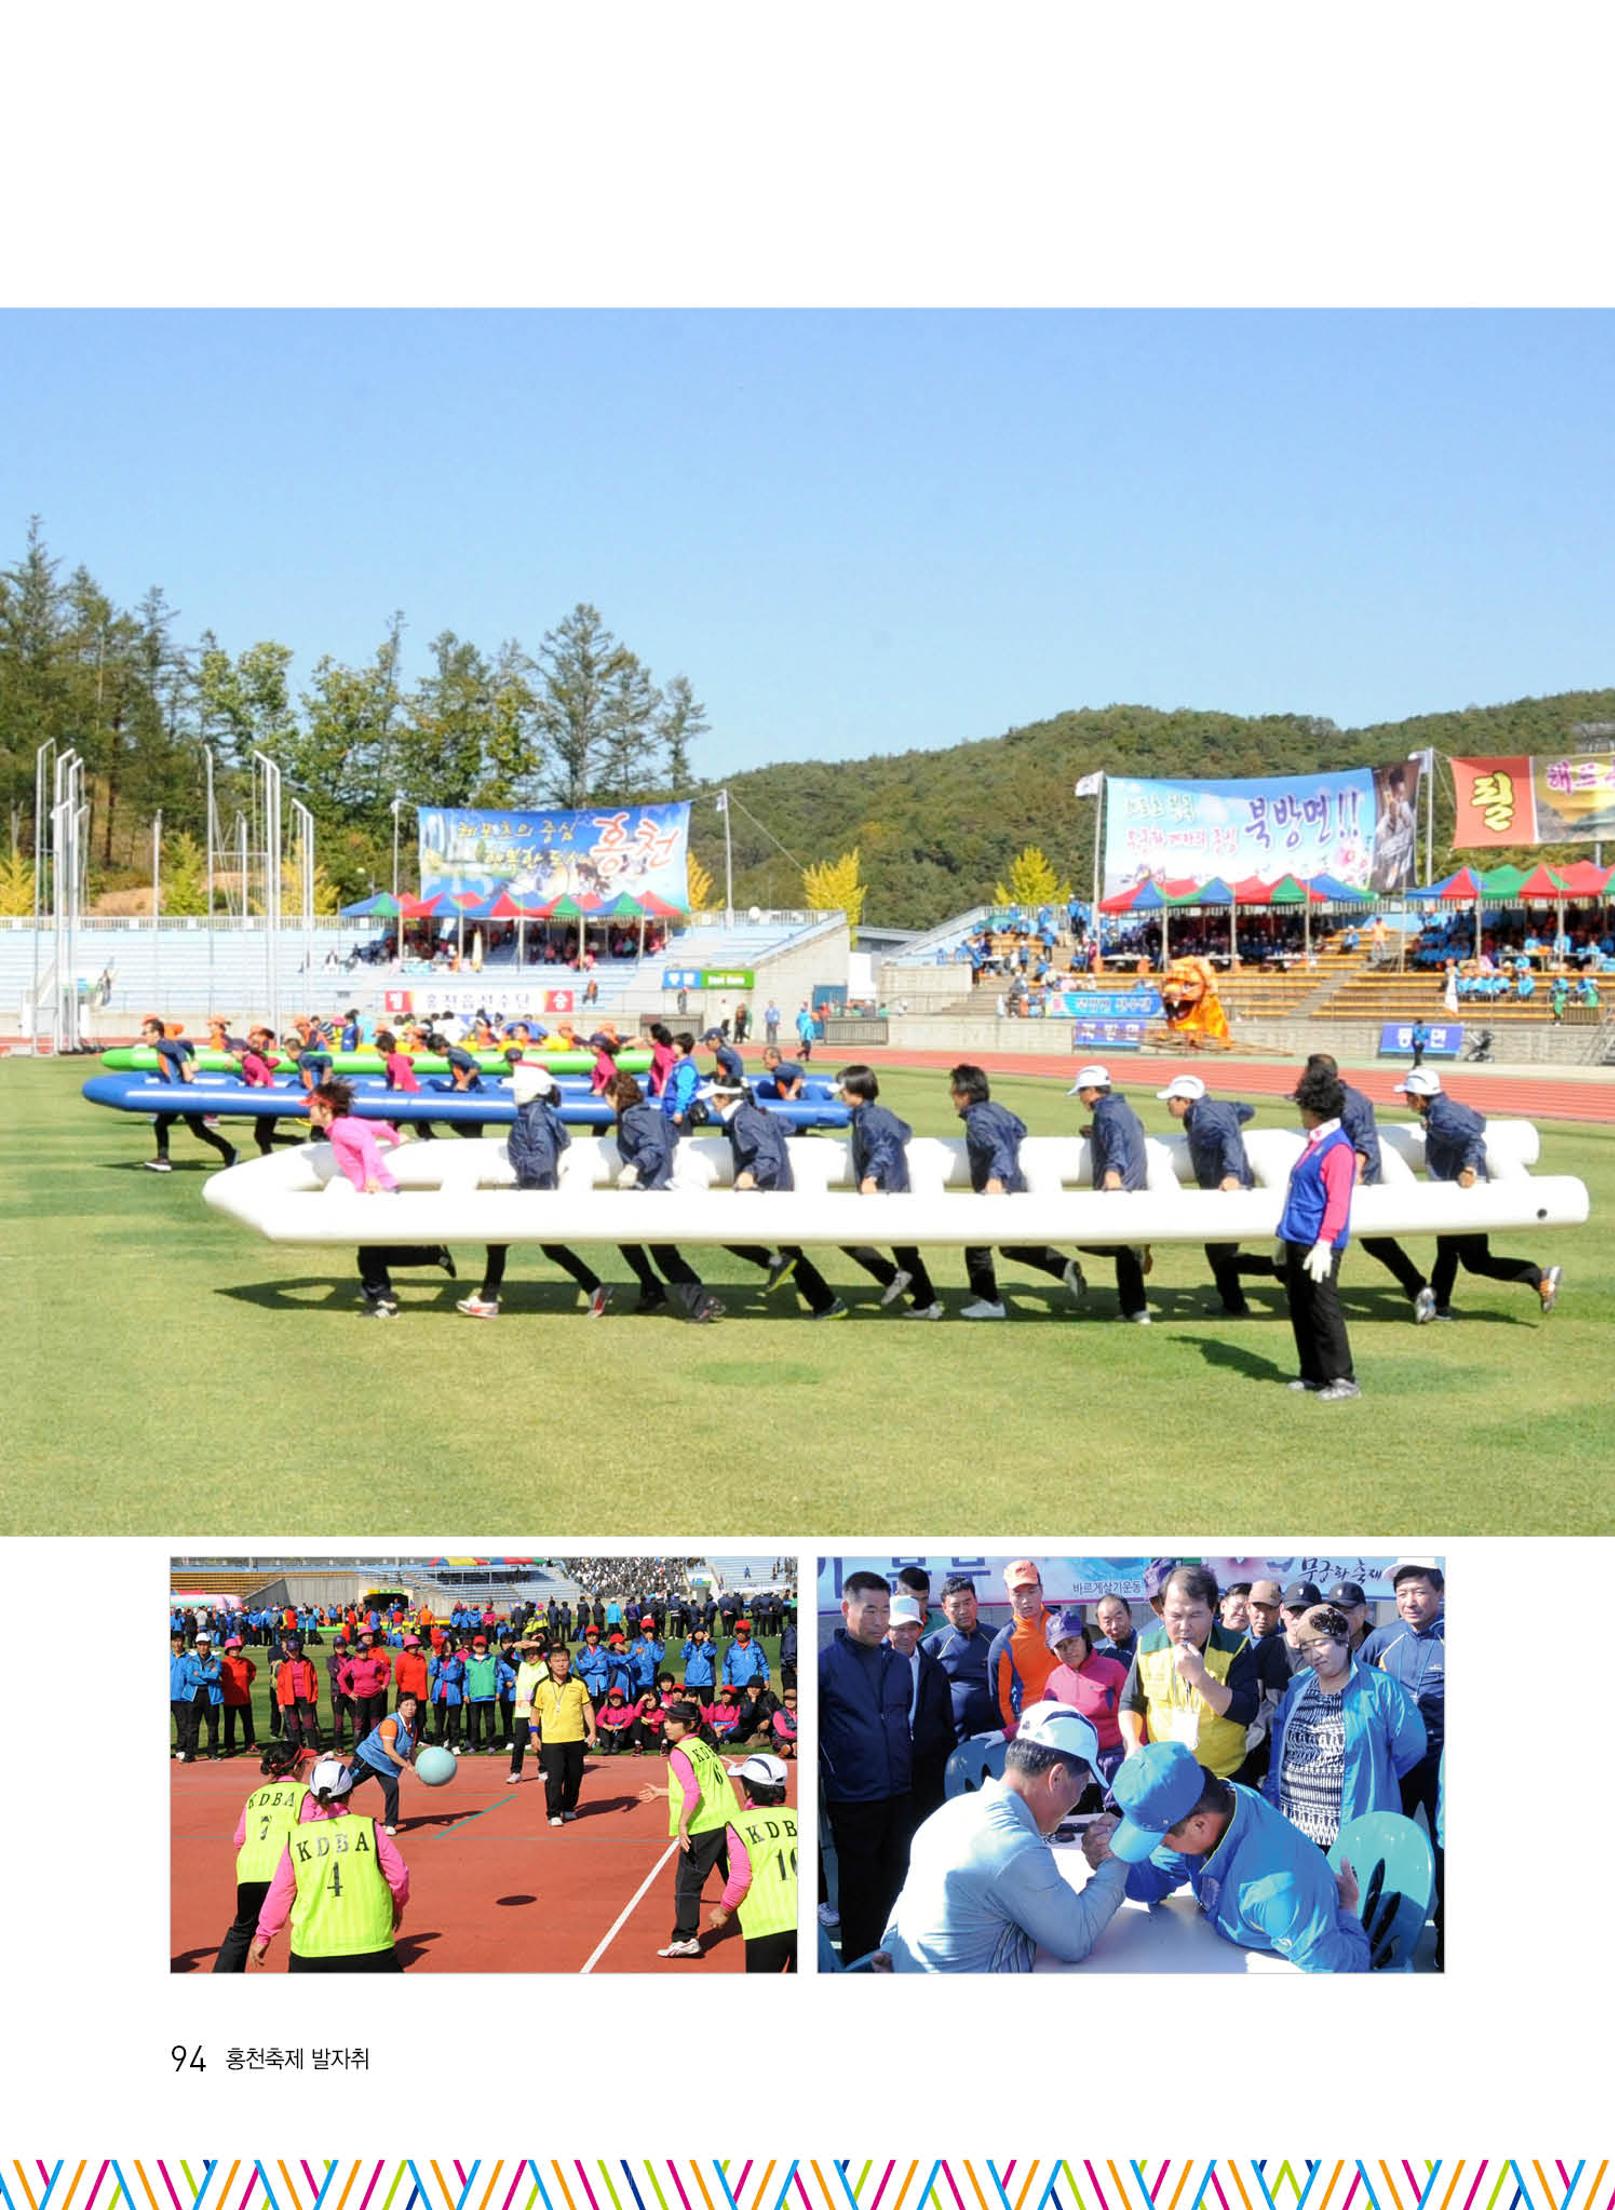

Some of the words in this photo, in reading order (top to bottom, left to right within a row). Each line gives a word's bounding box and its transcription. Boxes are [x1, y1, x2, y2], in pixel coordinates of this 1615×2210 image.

[1472, 769, 1513, 832] 필
[591, 812, 679, 875] 홍천
[1299, 1557, 1348, 1583] 무궁화
[1073, 1581, 1141, 1595] 바르게살기운동
[296, 1832, 369, 1862] KDBA
[327, 1861, 343, 1897] 4
